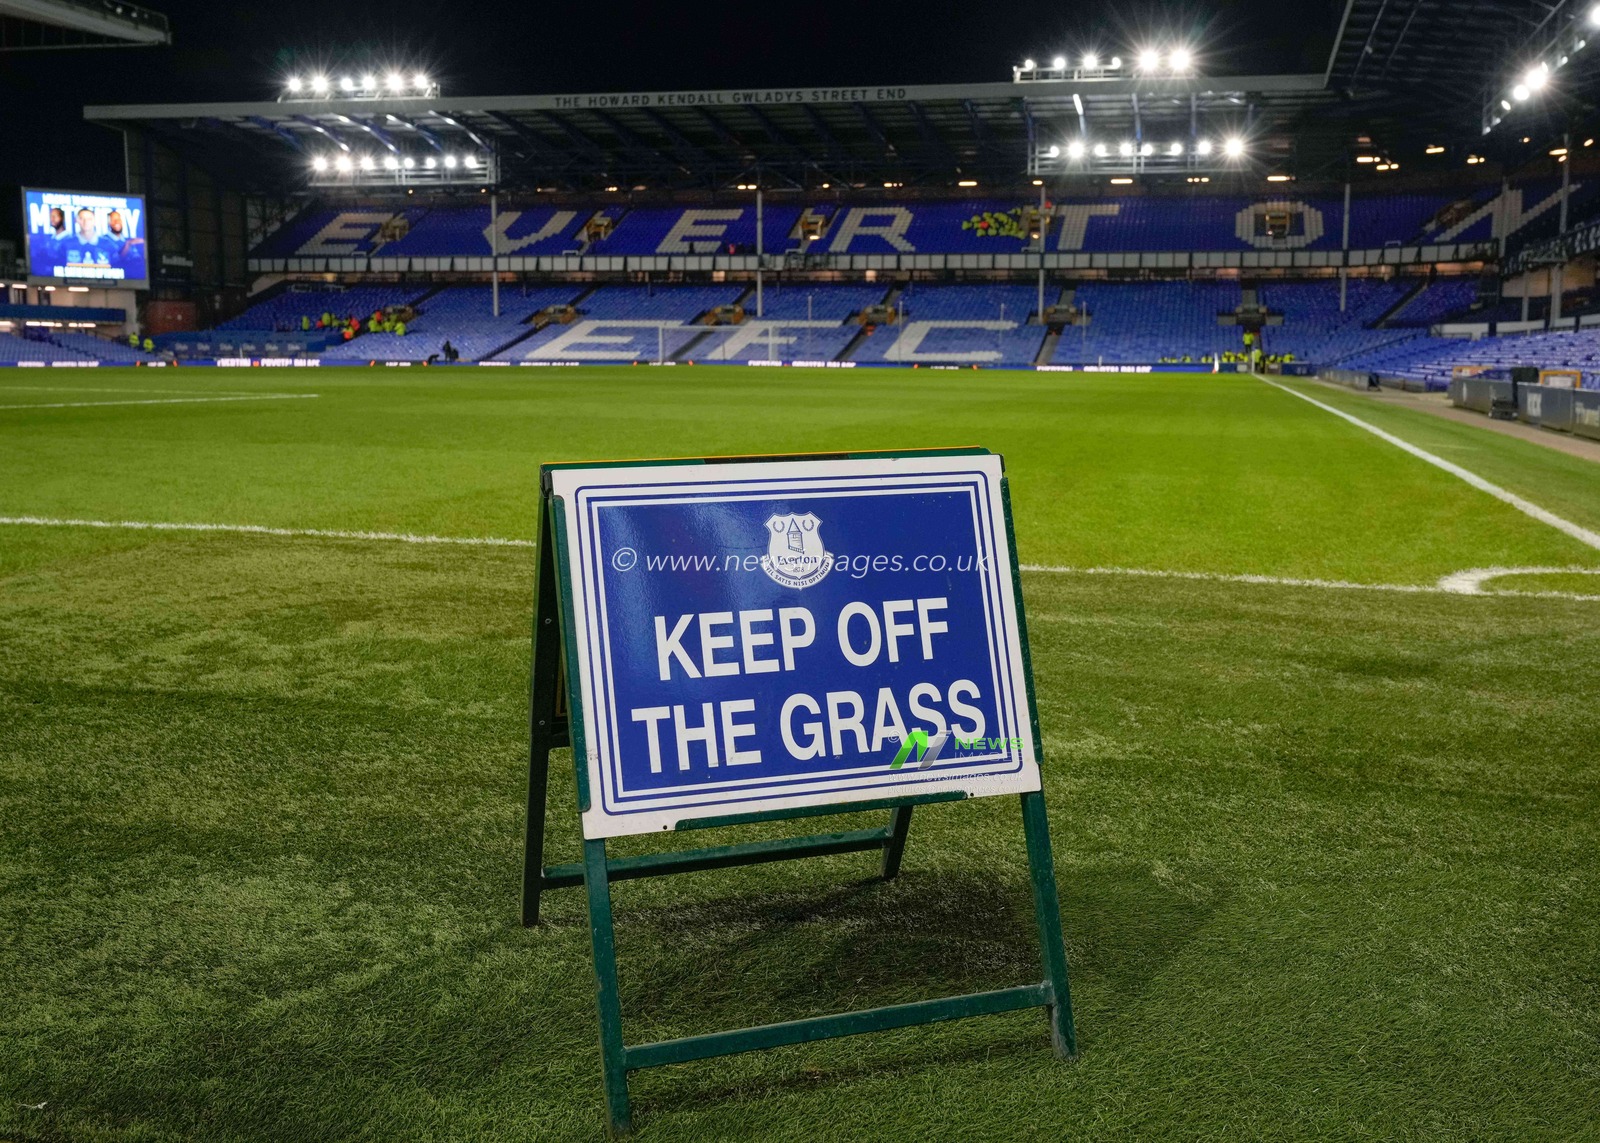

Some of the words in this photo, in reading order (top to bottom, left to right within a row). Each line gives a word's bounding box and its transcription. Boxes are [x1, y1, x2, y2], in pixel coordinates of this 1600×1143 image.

[555, 96, 580, 108] THE
[588, 95, 649, 107] HOWARD
[657, 93, 724, 105] KENDALL
[732, 91, 803, 103] GWLADYS
[812, 89, 868, 102] STREET
[877, 88, 906, 100] END
[774, 575, 792, 586] SATIS
[809, 561, 830, 584] OPTIMUM
[654, 606, 816, 681] KEEP
[837, 597, 949, 667] OFF
[631, 699, 763, 774] THE
[779, 679, 986, 761] GRASS
